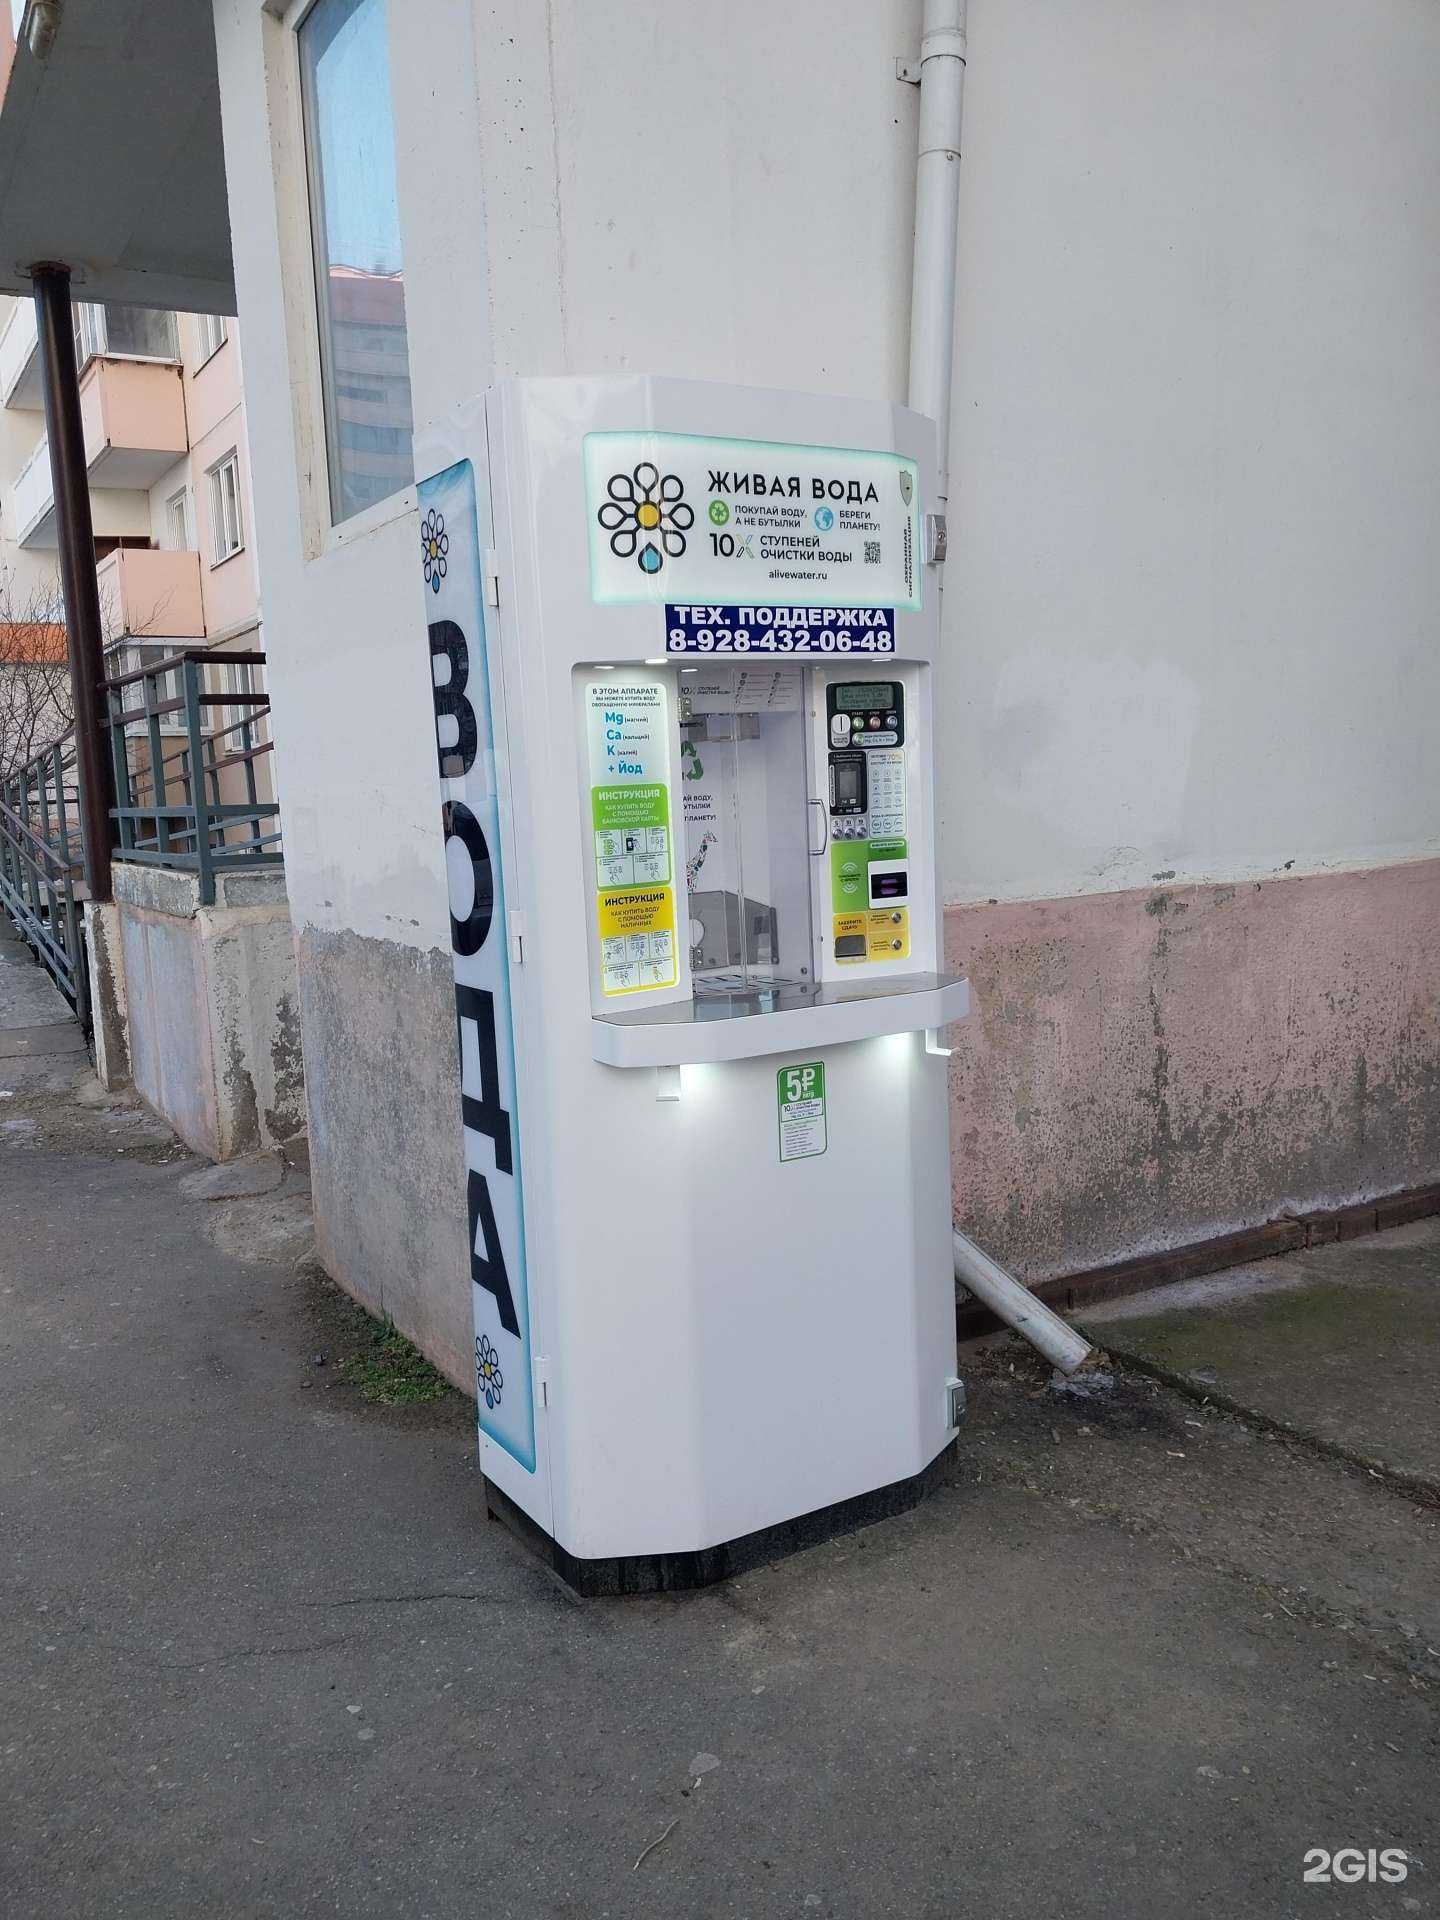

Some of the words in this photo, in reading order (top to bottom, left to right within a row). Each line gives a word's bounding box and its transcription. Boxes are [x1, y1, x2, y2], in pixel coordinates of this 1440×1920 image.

[708, 470, 801, 498] ЖИВАЯ
[812, 478, 879, 504] ВОДА
[734, 505, 779, 517] ПОКУПАЙ
[780, 506, 807, 518] ВОДУ,
[839, 510, 871, 519] БЕРЕГИ
[735, 517, 742, 527] А
[743, 517, 757, 527] НЕ
[758, 517, 801, 529] БУТЫЛКИ
[839, 521, 880, 532] ПЛАНЕТУ!
[760, 534, 820, 548] СТУПЕНЕЙ
[760, 549, 814, 561] ОЧИСТКИ
[818, 551, 853, 563] ВОДЫ
[768, 569, 828, 581] alivewater.ru
[675, 606, 731, 626] ТЕХ.
[739, 607, 887, 629] ПОДДЕРЖКА
[669, 629, 893, 652] 8-928-432-06-48
[620, 687, 658, 695] АППАРАТЕ
[605, 712, 623, 725] Mg
[606, 729, 622, 740] Ca
[618, 760, 642, 774] Йод
[598, 789, 660, 800] ИНСТРУКЦИЯ
[604, 893, 665, 906] ИНСТРУКЦИЯ
